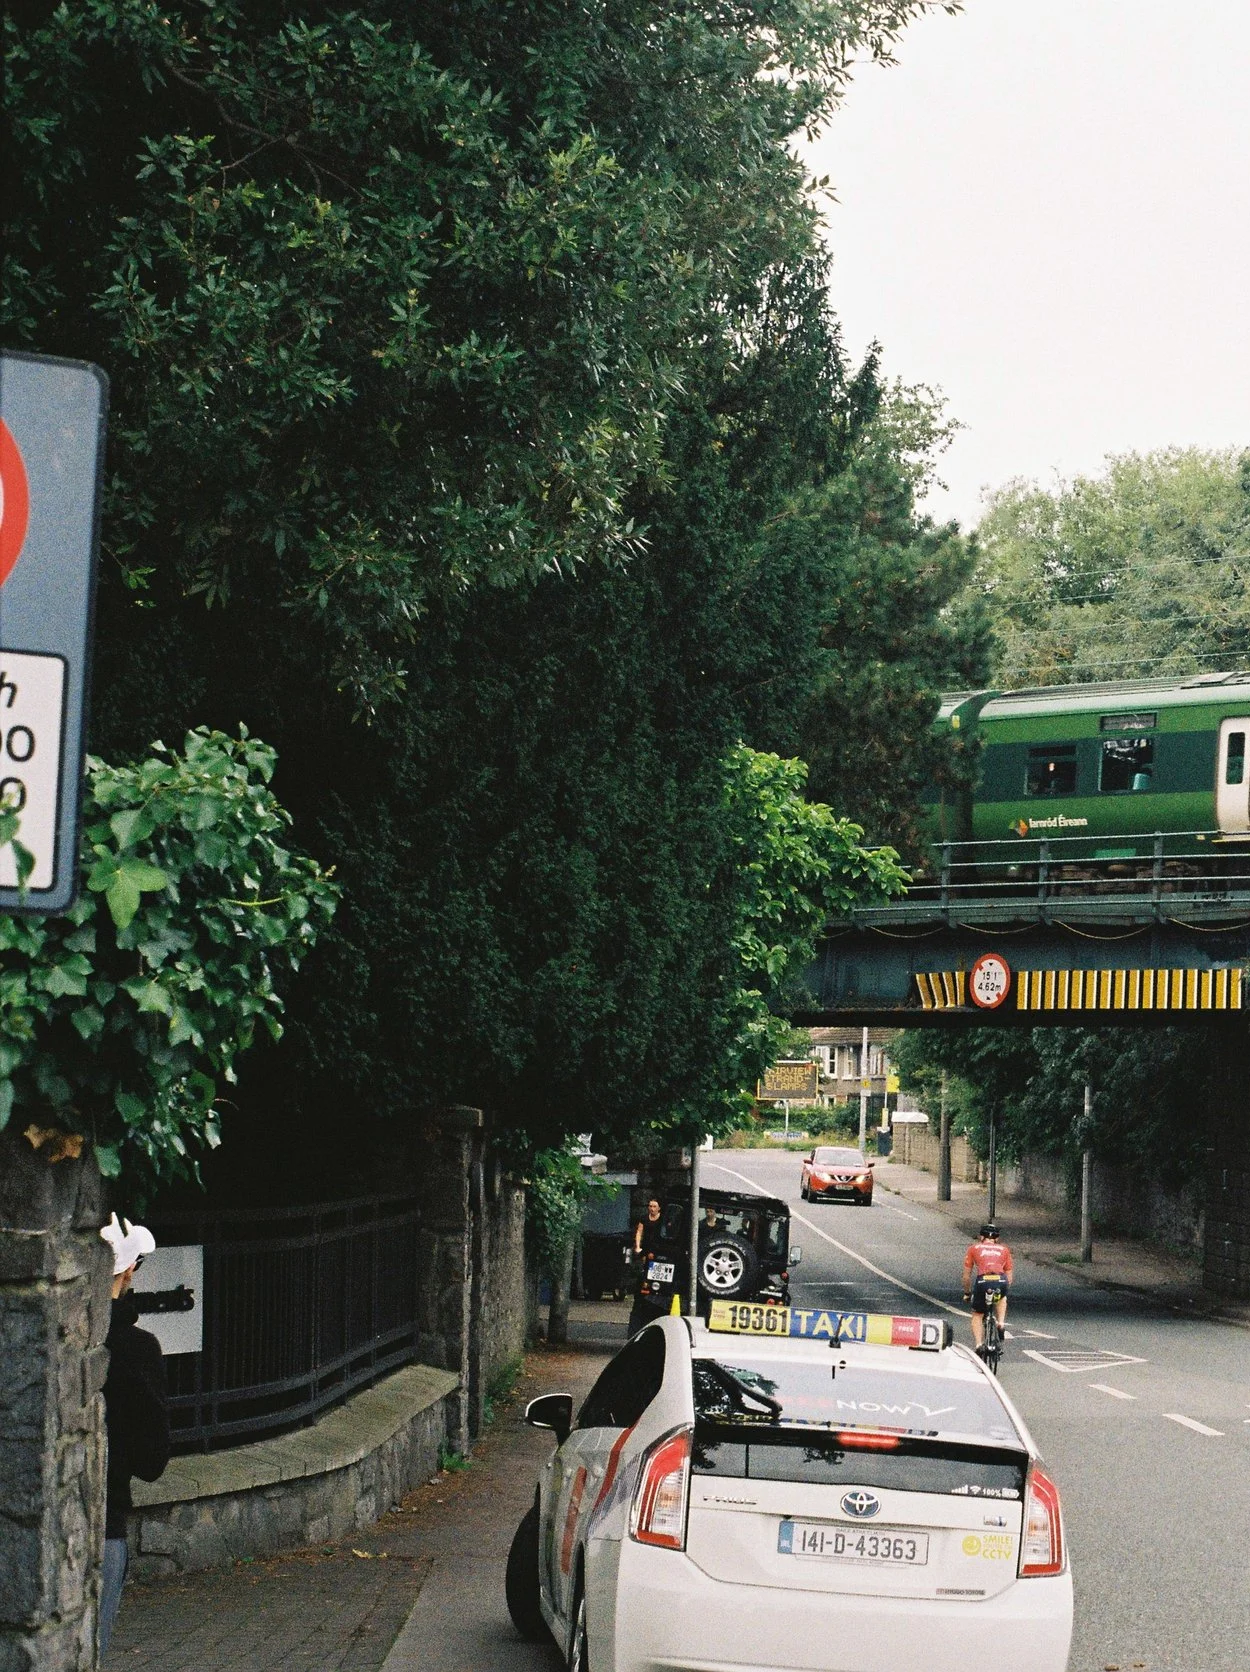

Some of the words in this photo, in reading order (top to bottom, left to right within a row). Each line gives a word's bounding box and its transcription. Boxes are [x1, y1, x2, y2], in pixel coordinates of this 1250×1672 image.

[978, 982, 1002, 992] 4.62m
[728, 1304, 788, 1333] 19361
[794, 1310, 865, 1340] TAXI
[921, 1323, 940, 1346] D
[982, 1487, 1002, 1498] 100%
[801, 1529, 918, 1561] 141-D-43363
[982, 1549, 1012, 1560] CCTV
